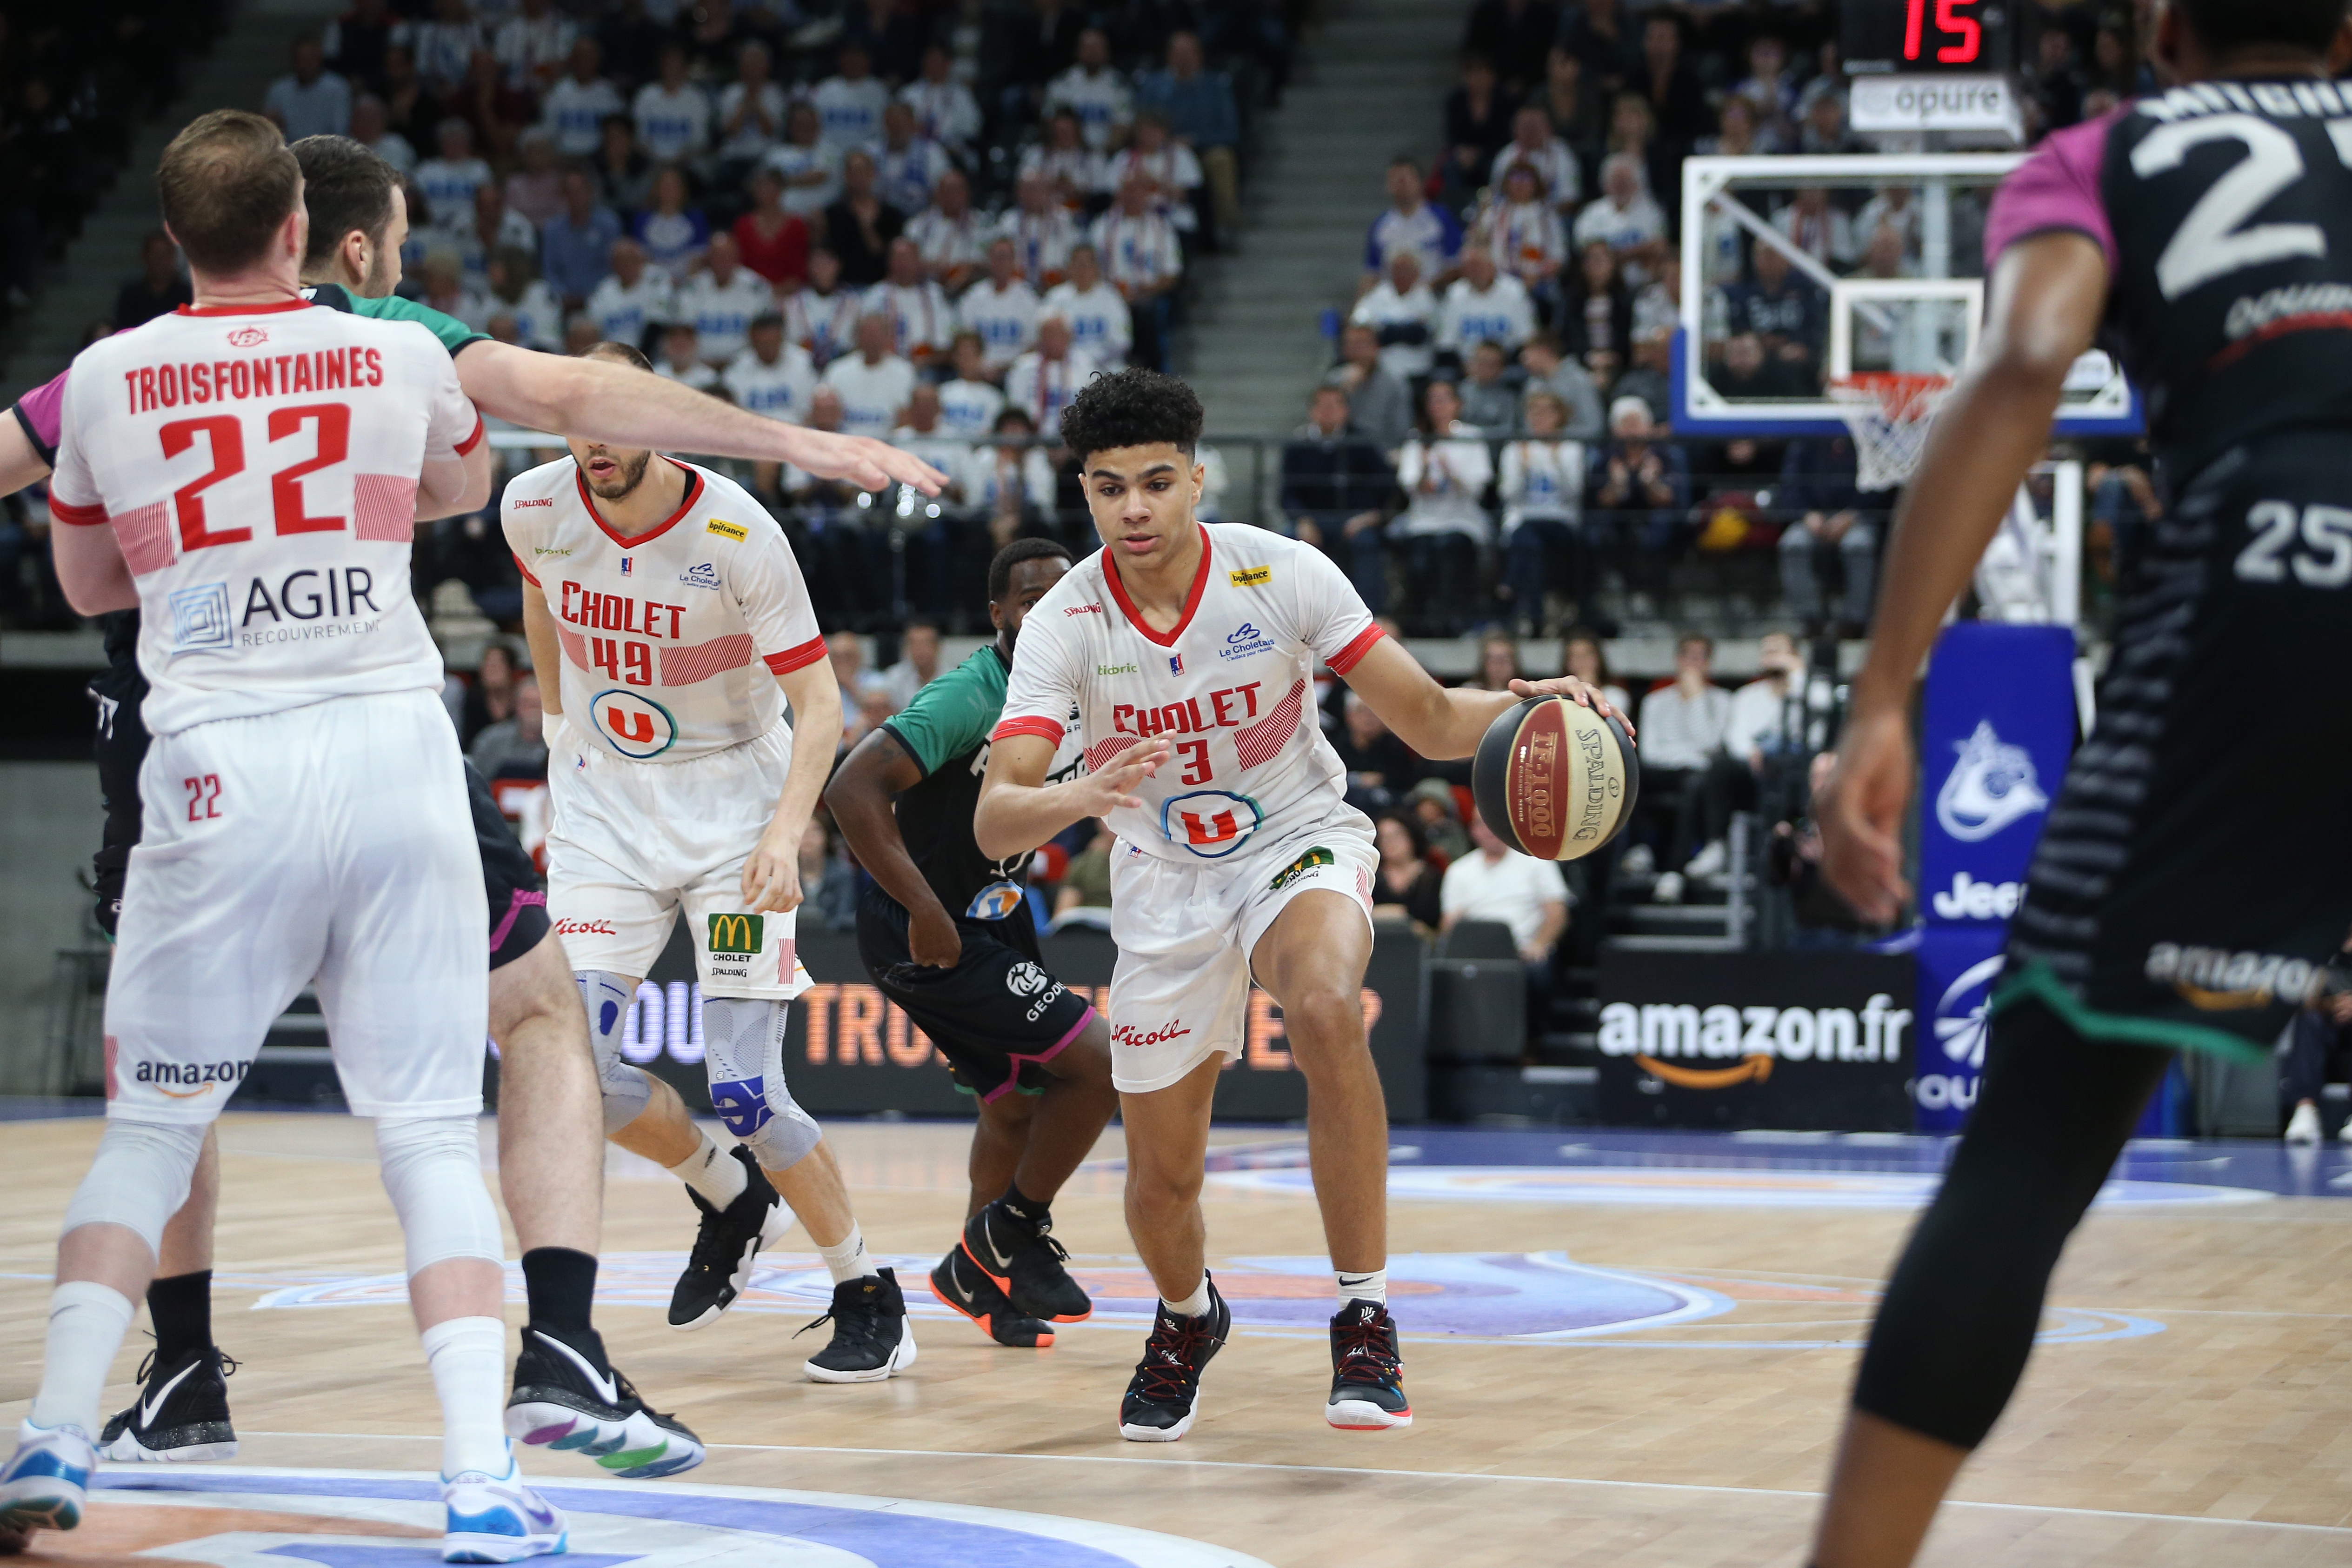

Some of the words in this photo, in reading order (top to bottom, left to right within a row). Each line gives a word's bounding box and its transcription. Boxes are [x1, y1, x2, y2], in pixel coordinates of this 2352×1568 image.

[1904, 0, 1982, 63] 15
[2129, 112, 2352, 306] 2
[126, 347, 384, 415] TROISFONTAINES
[159, 402, 352, 553] 22
[514, 498, 553, 510] SPALDING
[709, 521, 745, 538] bpifrance
[2232, 499, 2352, 589] 25
[242, 567, 382, 627] AGIR
[561, 580, 686, 639] CHOLET
[1063, 601, 1101, 617] SPALDNG
[591, 636, 653, 686] 49
[1233, 639, 1275, 652] Choletais
[1113, 681, 1261, 738] CHOLET
[1176, 739, 1213, 786] 3
[1532, 734, 1553, 836] TF-1000
[1572, 728, 1606, 843] SPALDING
[185, 774, 223, 822] 22
[1932, 871, 2022, 920] Jee
[711, 967, 747, 977] SPALDING
[713, 954, 752, 962] CHOLET
[1111, 1018, 1191, 1047] Nicoll
[1597, 993, 1913, 1063] amazon.fr
